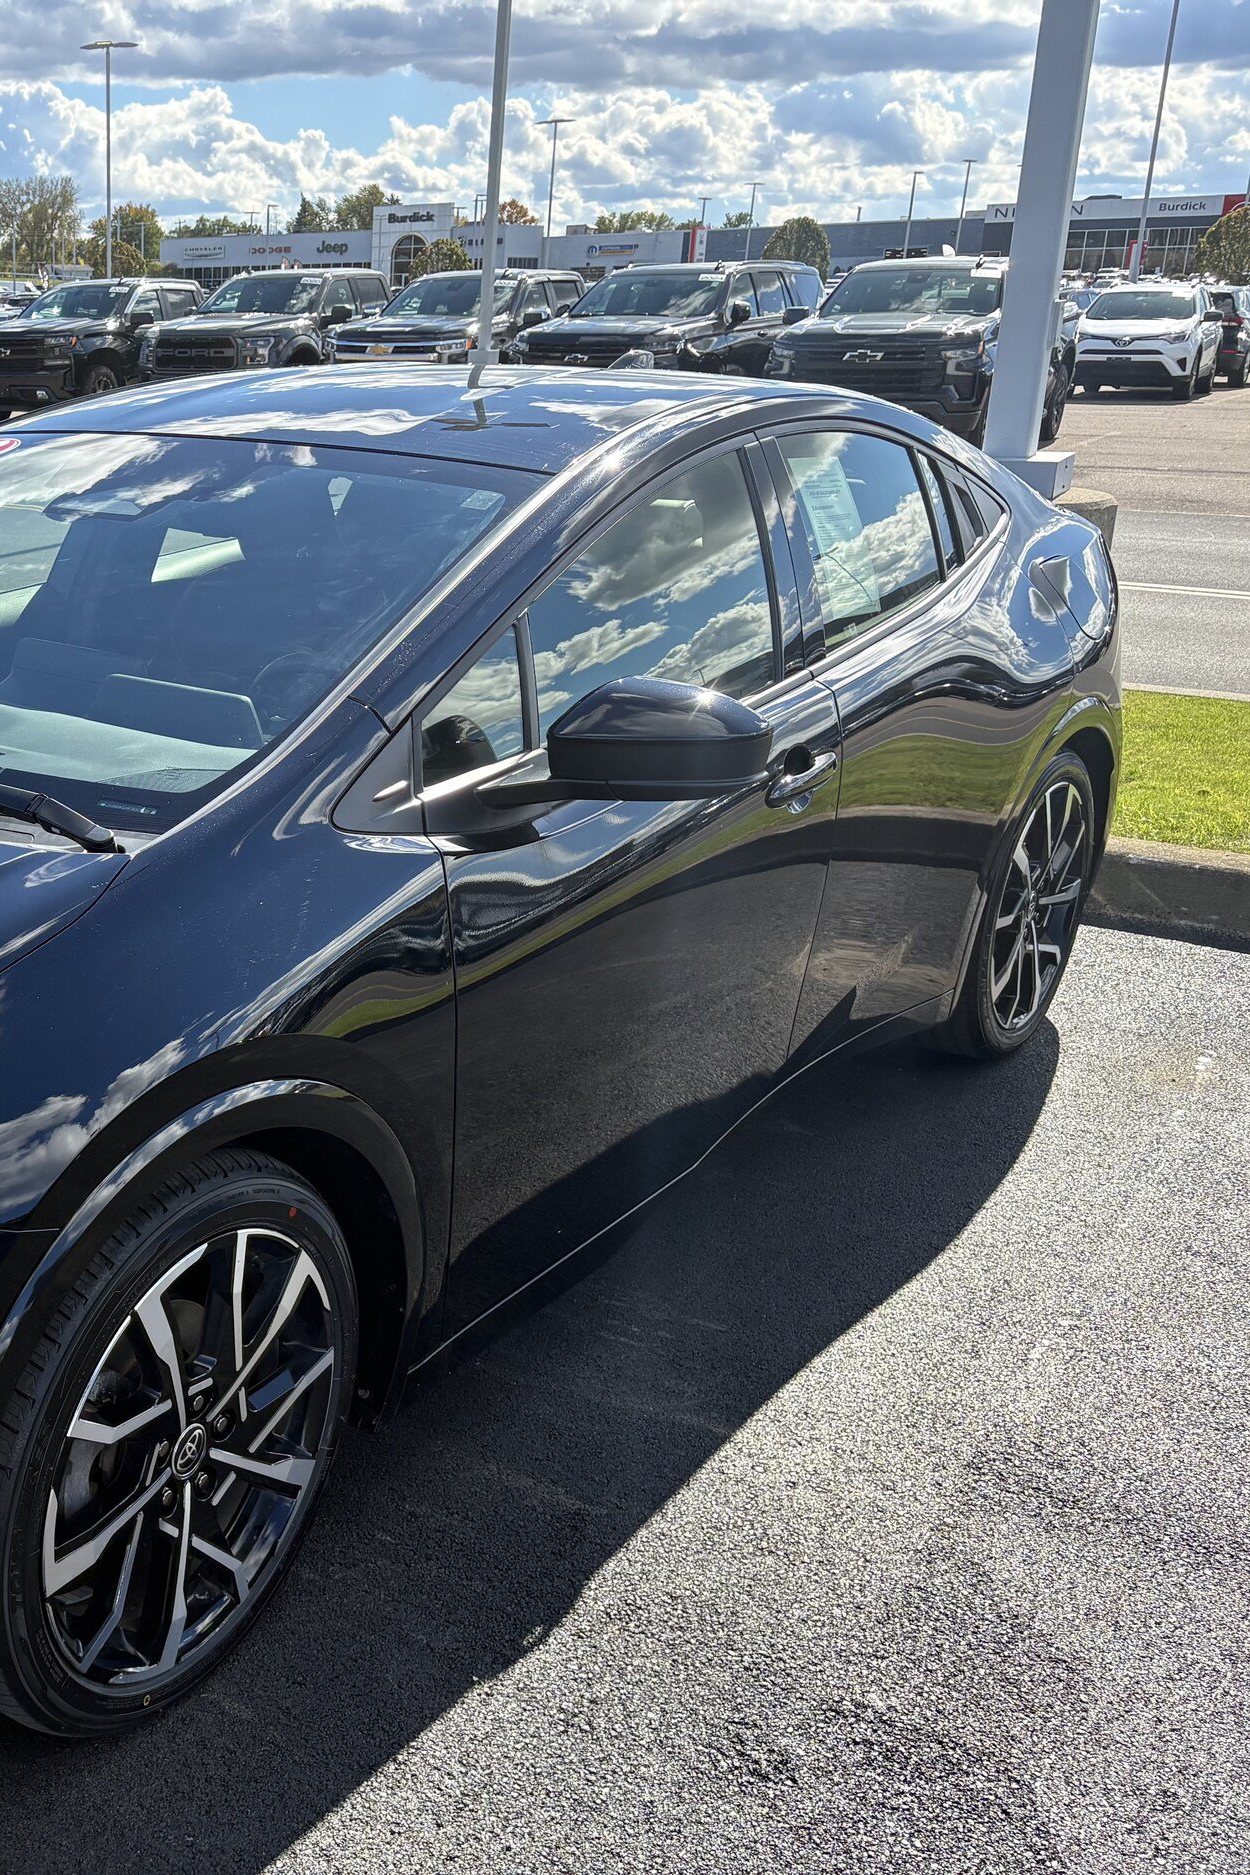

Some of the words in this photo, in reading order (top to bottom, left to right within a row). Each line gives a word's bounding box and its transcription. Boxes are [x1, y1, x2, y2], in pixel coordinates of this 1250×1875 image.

[1158, 201, 1207, 212] Burdick
[388, 211, 435, 224] Burdick
[249, 246, 292, 255] DODGE
[316, 240, 349, 255] Jeep
[157, 348, 234, 357] FORD
